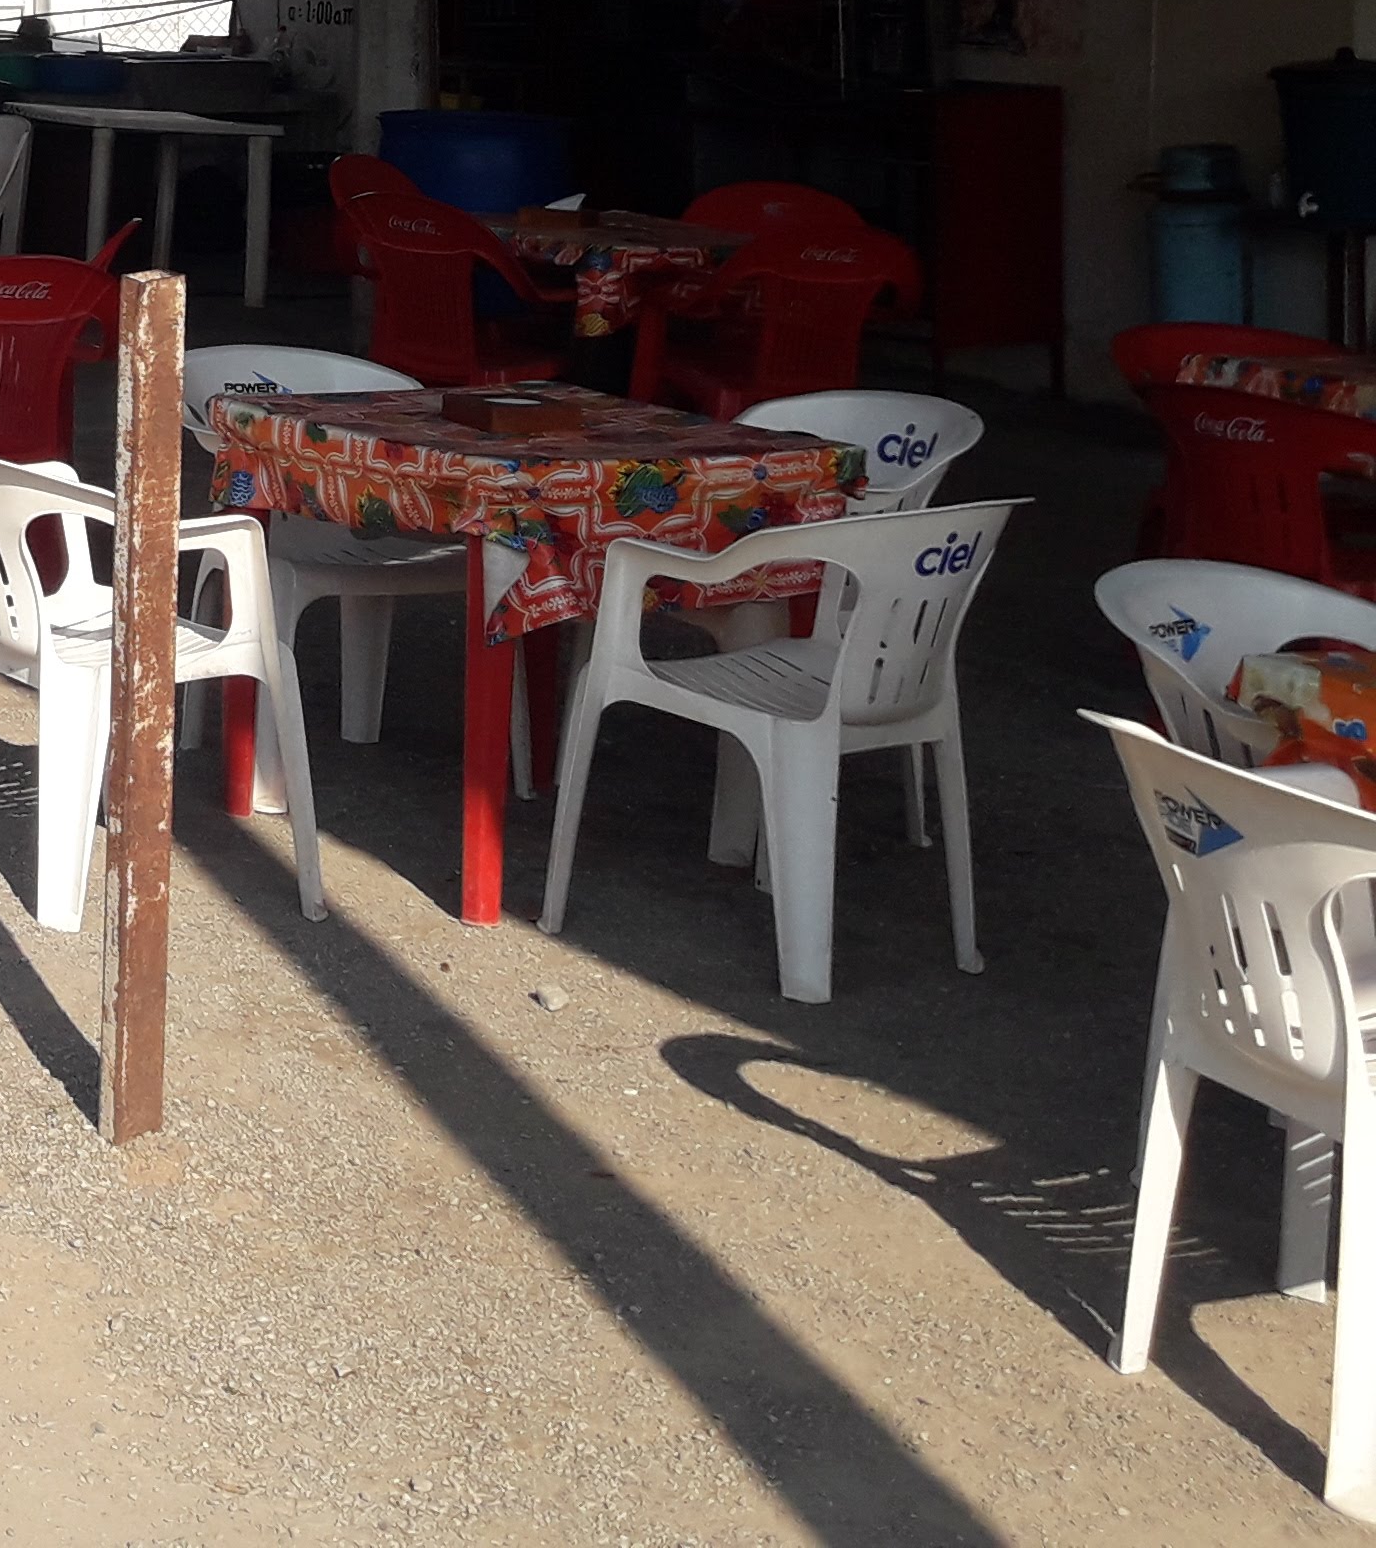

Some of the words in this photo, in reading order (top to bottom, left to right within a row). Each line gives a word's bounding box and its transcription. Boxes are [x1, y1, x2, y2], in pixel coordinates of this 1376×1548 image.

[224, 382, 278, 393] POWER
[877, 423, 939, 468] ciel
[915, 531, 983, 577] ciel
